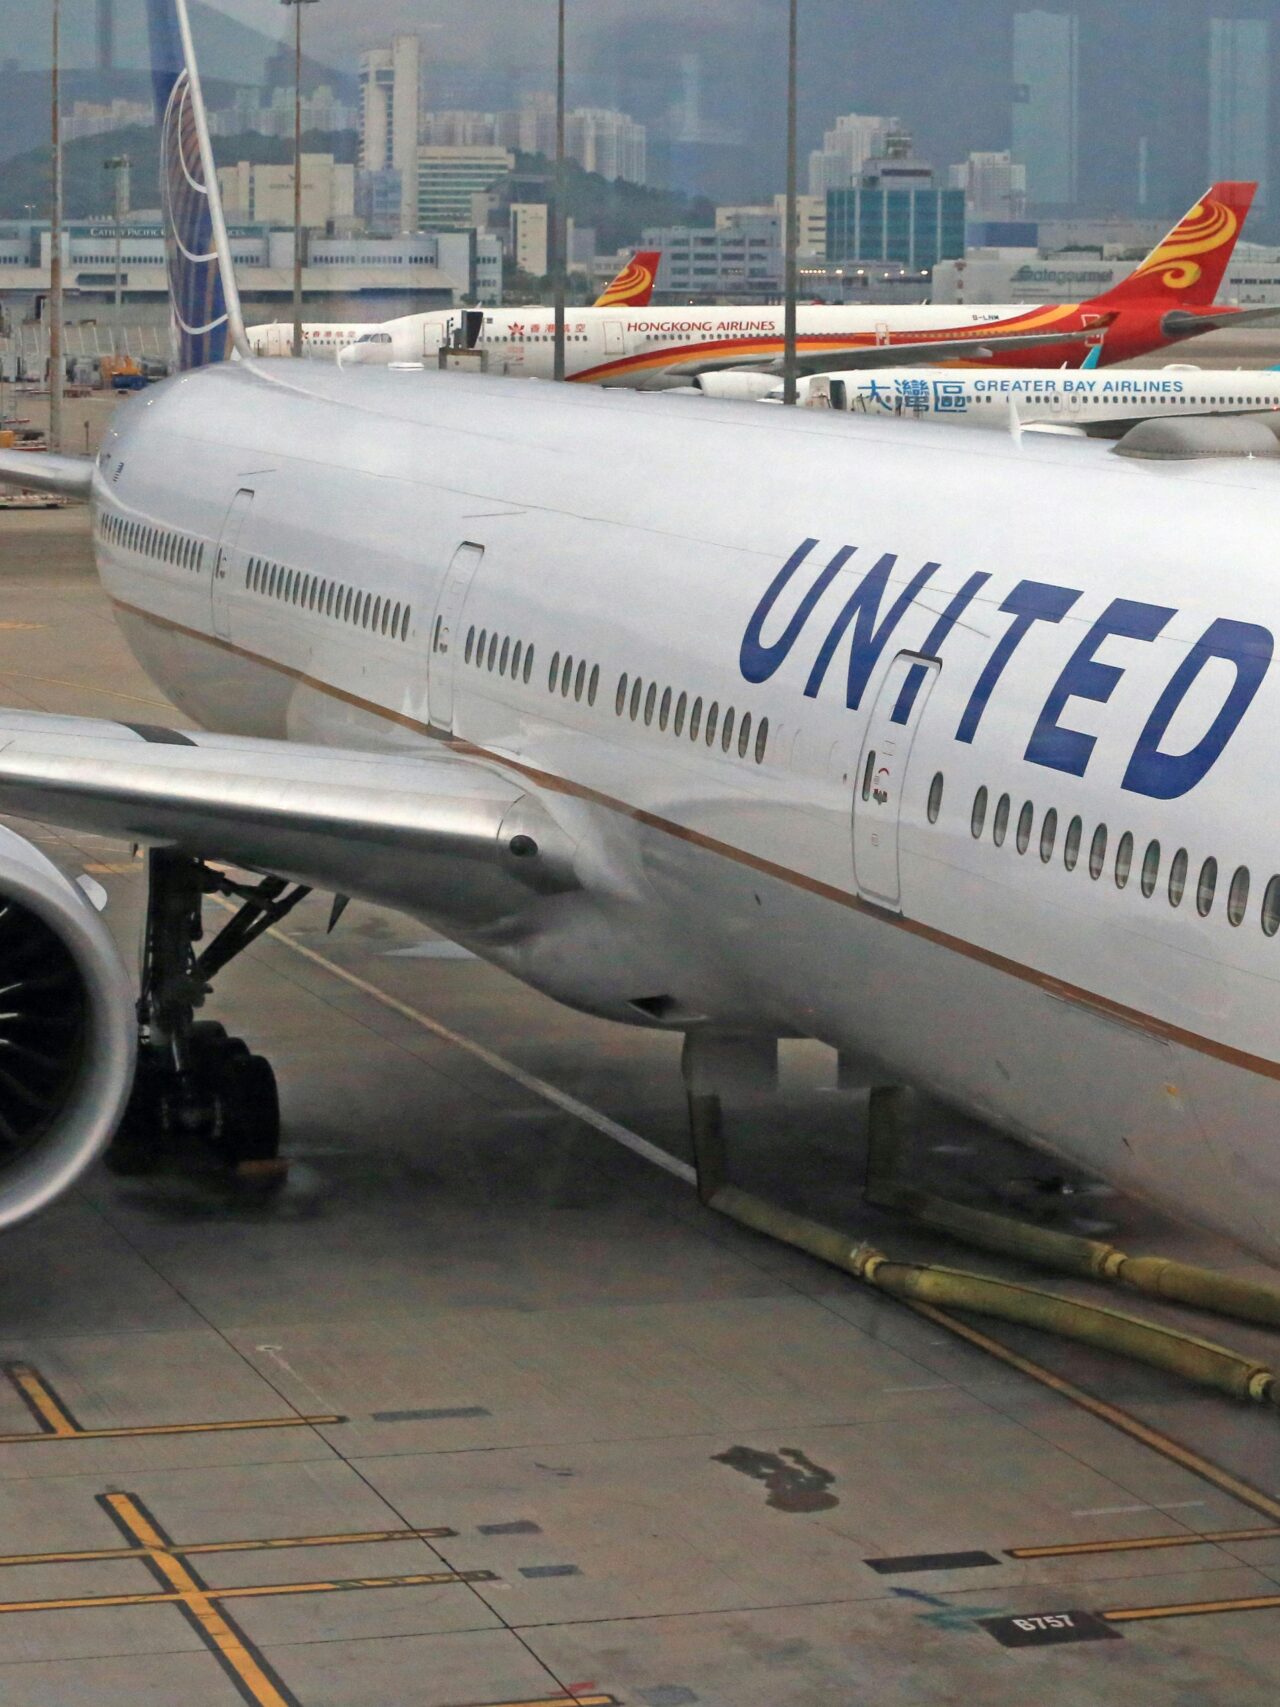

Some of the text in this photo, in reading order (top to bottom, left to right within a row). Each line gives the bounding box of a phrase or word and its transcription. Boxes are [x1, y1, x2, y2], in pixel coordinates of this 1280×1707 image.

[627, 320, 775, 332] HONGKONG AIRLINES
[974, 380, 1183, 393] GREATER BAY AIRLINES
[857, 379, 968, 413] 大灣區
[739, 537, 1275, 800] UNITED
[1012, 1615, 1075, 1631] B757
